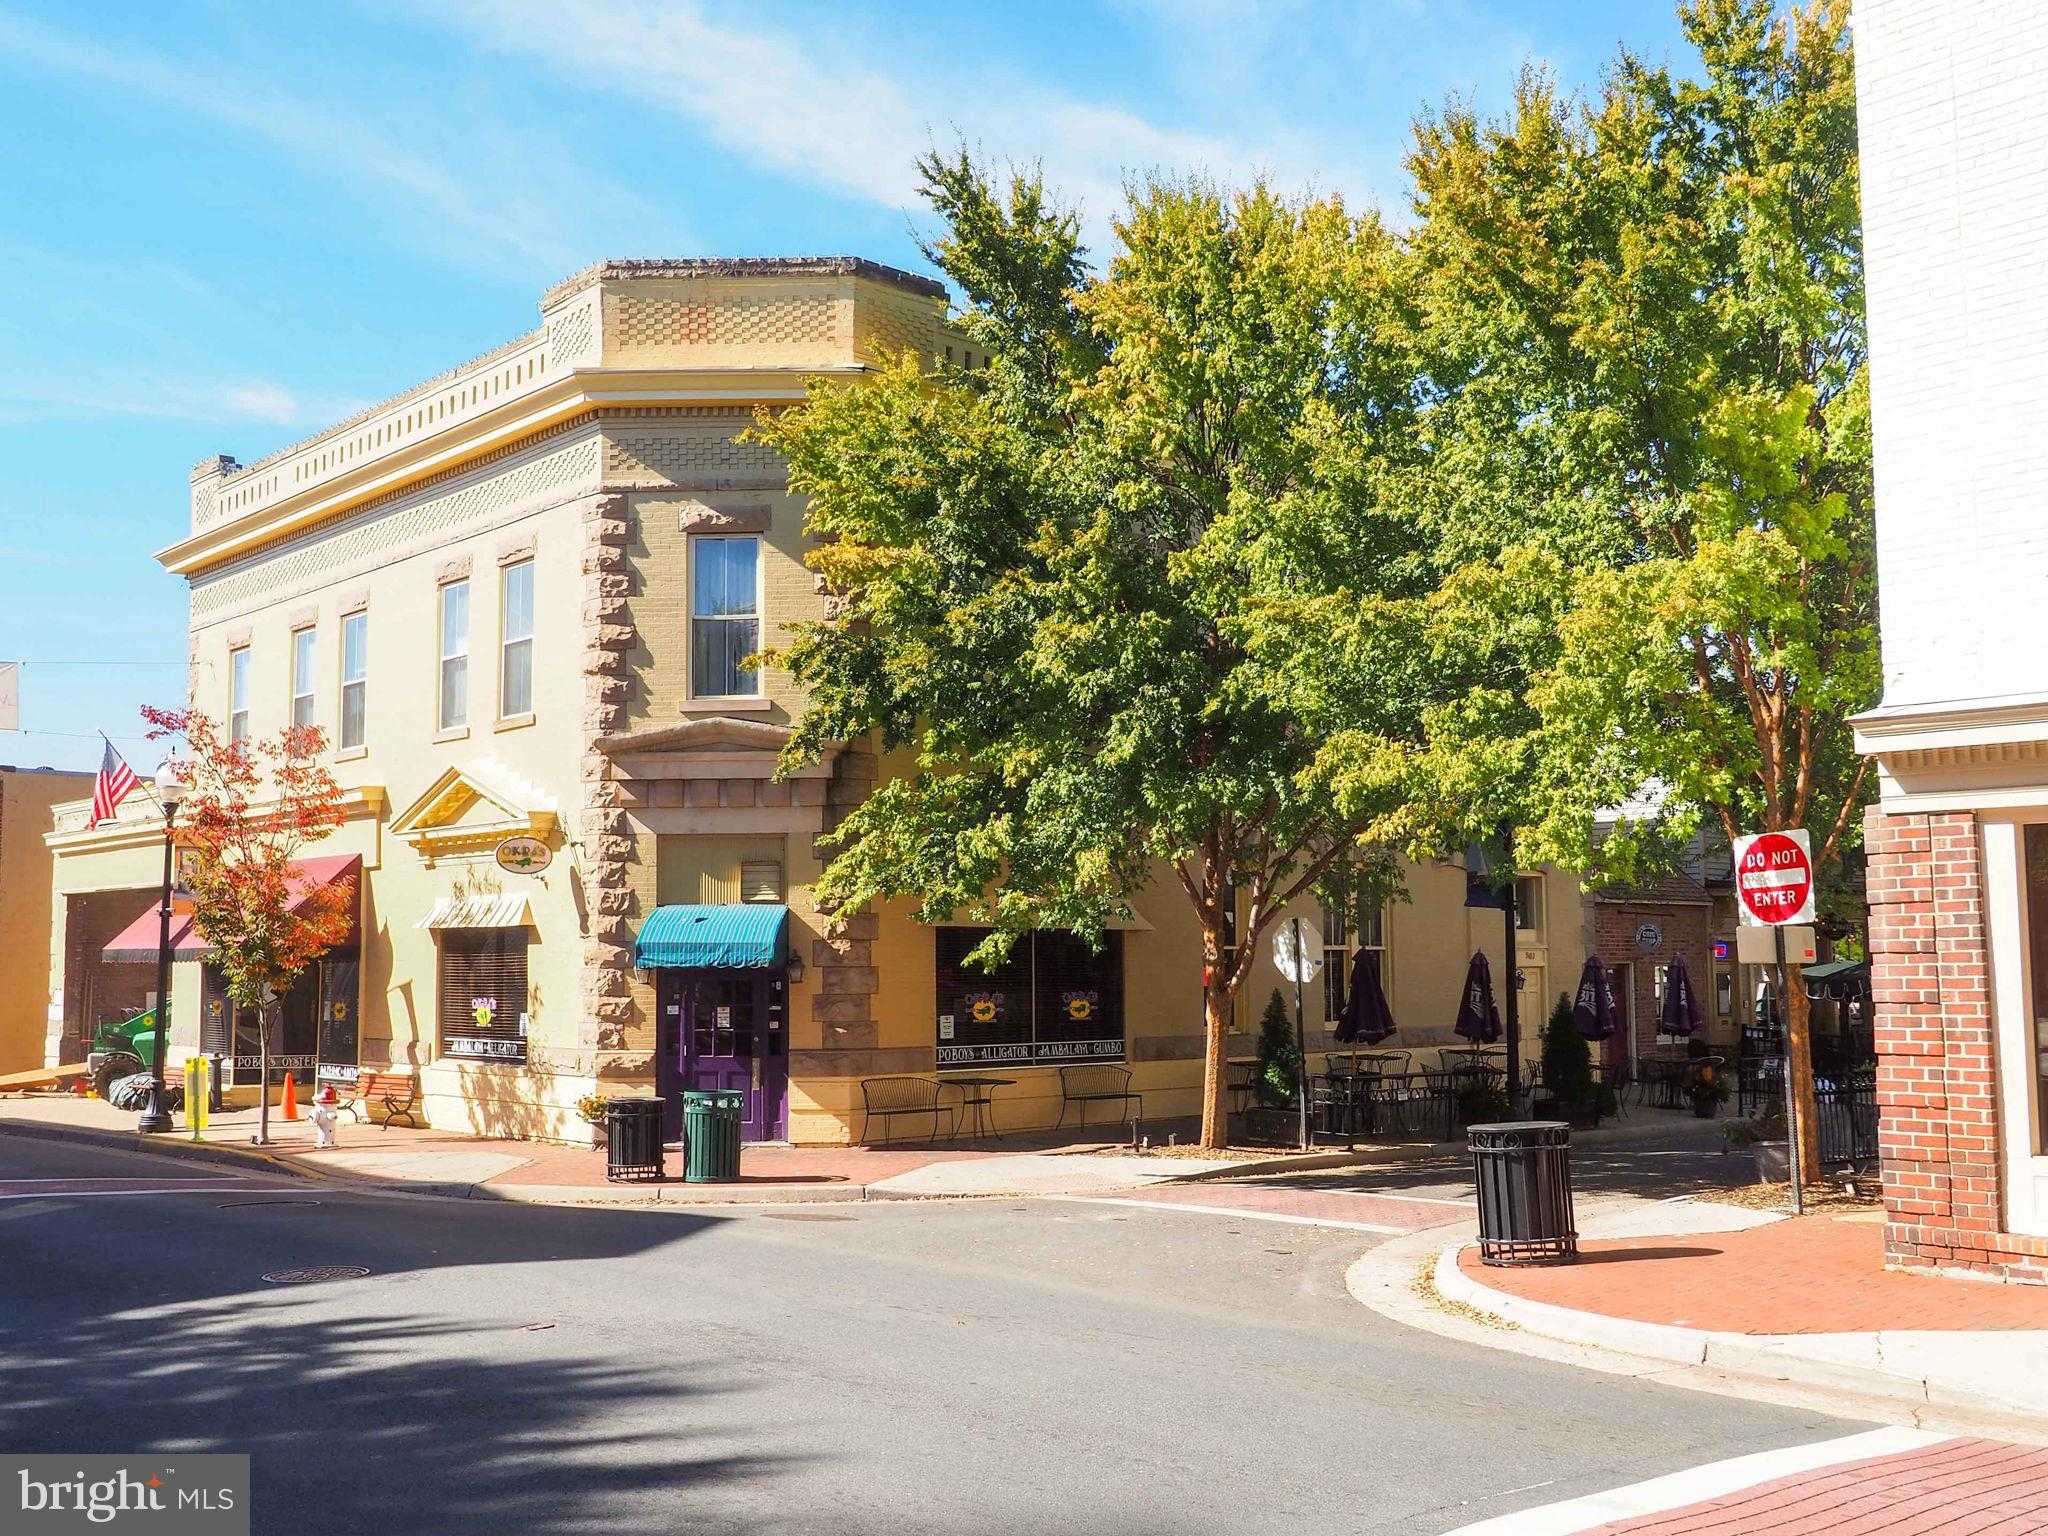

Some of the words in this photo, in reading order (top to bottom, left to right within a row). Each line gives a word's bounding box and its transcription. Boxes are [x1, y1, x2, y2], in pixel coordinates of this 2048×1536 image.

[1746, 852, 1765, 868] DO
[1772, 849, 1798, 865] NOT
[1753, 890, 1796, 907] ENTER
[981, 1045, 1028, 1059] ALLIGATOR
[1094, 1041, 1122, 1054] GUMBO
[282, 1056, 318, 1067] OYSTER
